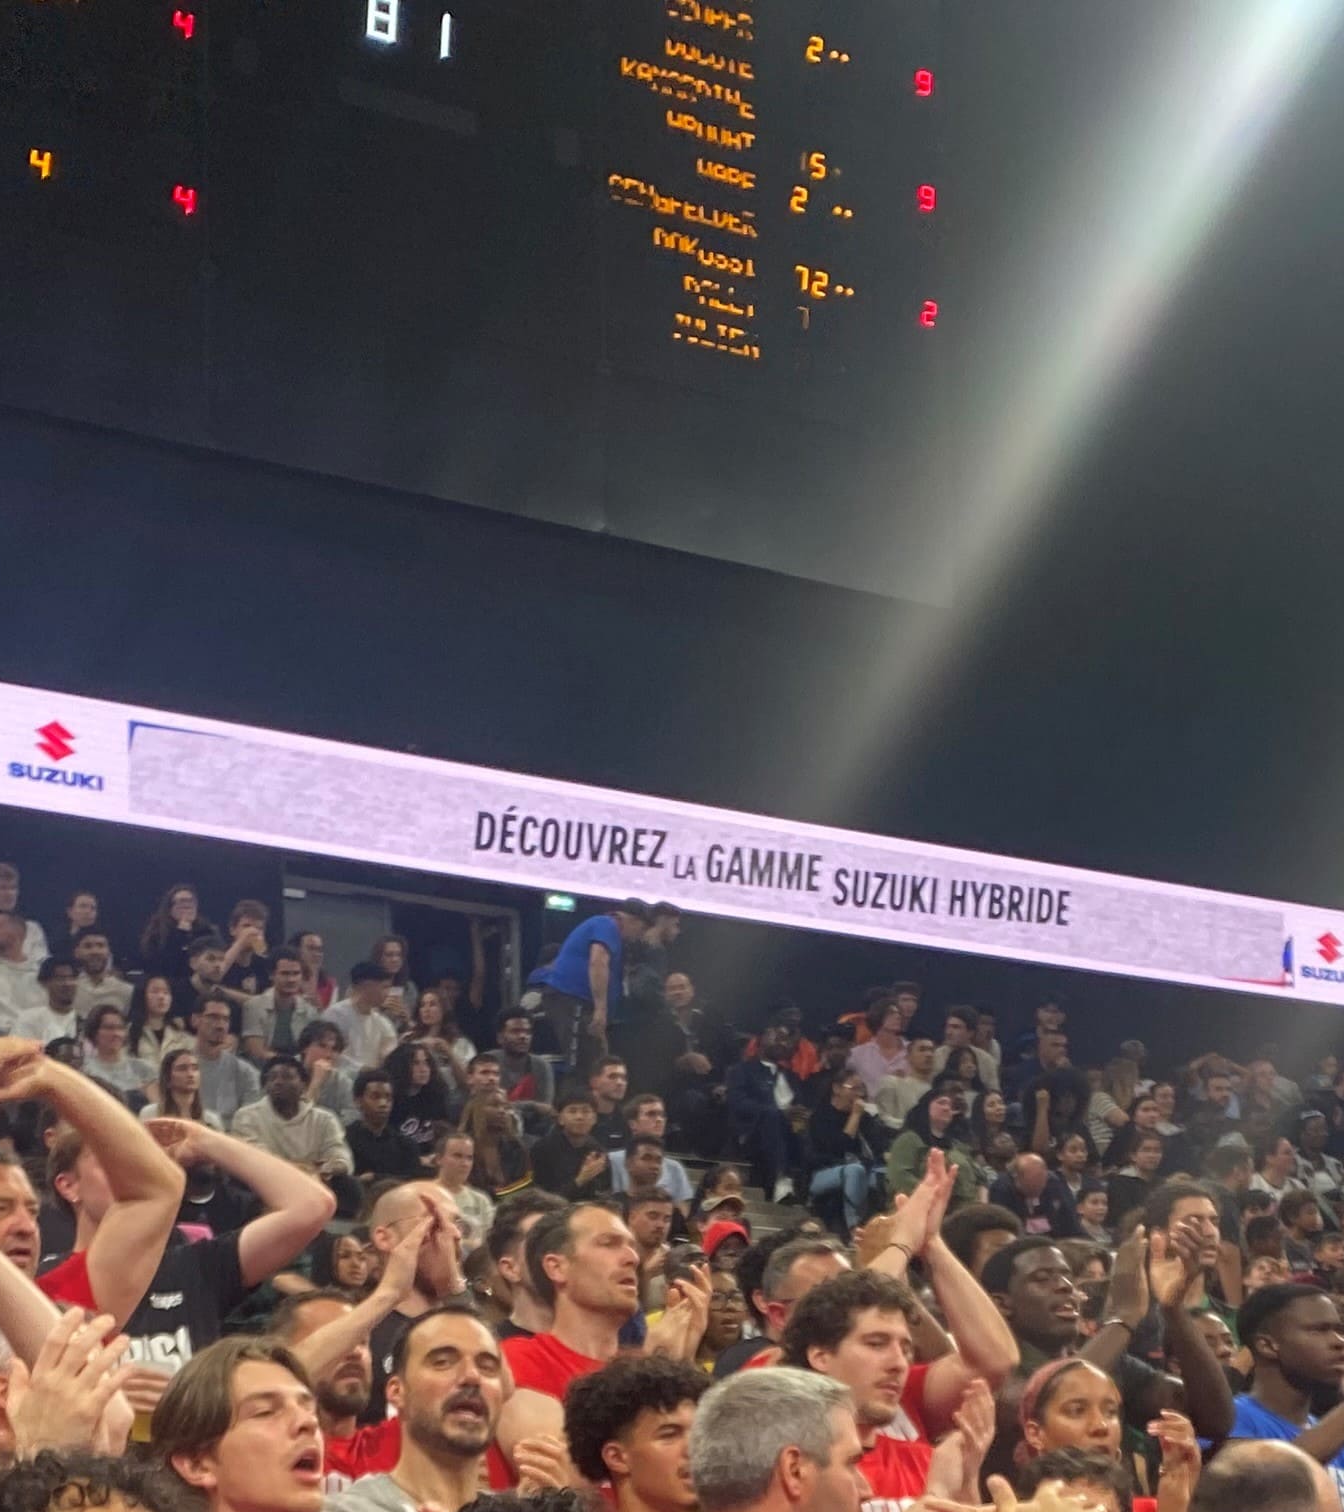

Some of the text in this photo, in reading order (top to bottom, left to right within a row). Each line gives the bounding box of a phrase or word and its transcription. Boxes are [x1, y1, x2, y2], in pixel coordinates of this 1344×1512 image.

[29, 148, 52, 180] 4
[174, 185, 197, 215] 4
[917, 184, 936, 212] 9
[920, 300, 937, 327] 2
[8, 761, 104, 792] SUZUKI
[474, 805, 1071, 925] DÉCOUVREZ LA GAMME SUZUKI HYBRIDE
